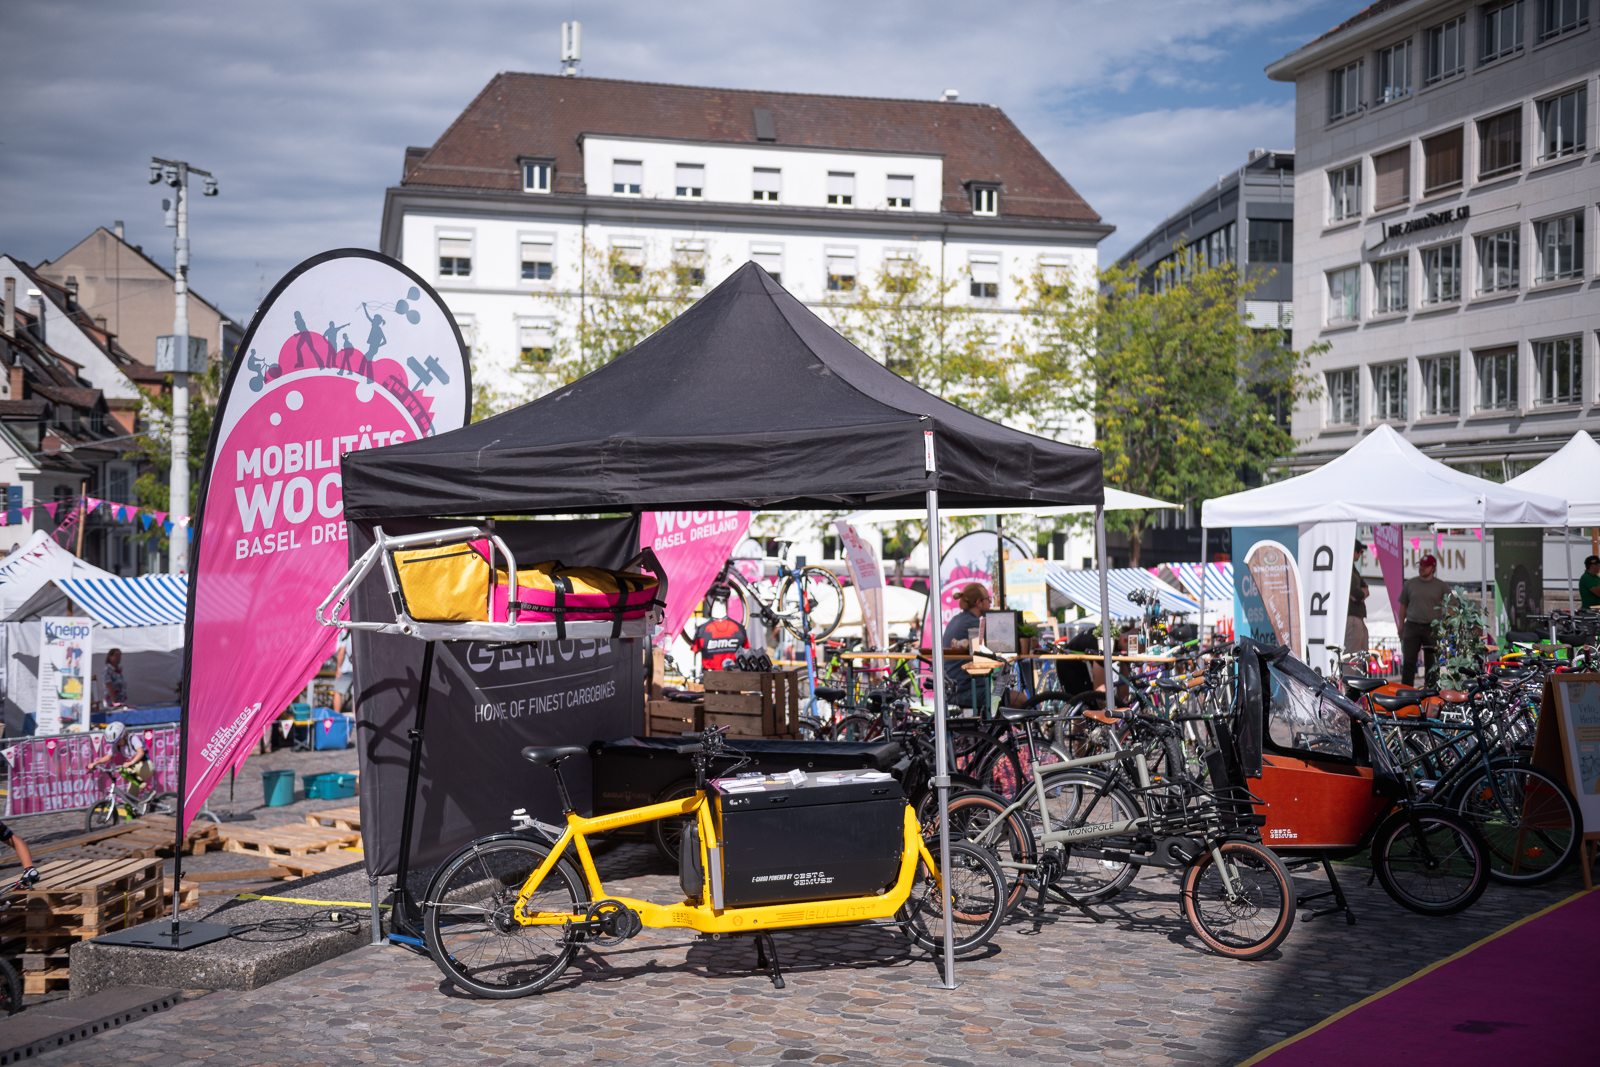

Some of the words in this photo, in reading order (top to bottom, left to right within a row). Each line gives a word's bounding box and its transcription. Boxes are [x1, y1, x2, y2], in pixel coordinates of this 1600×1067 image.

[236, 424, 406, 481] MOBILITÄTS
[234, 472, 344, 533] WOC
[236, 530, 301, 560] BASEL
[655, 532, 686, 551] BASEL
[690, 517, 738, 542] DREILAND
[1242, 602, 1264, 623] Less
[1306, 545, 1334, 676] IRD
[44, 622, 90, 639] Kneipp
[1251, 627, 1277, 645] More
[475, 702, 508, 722] HOME
[510, 700, 525, 718] OF
[528, 692, 565, 715] FINEST
[566, 680, 616, 708] CARGOBIKES
[200, 726, 229, 758] BASEL
[206, 706, 252, 763] UNTERWEGS
[215, 748, 232, 767] schlau
[230, 736, 241, 749] ans
[238, 725, 249, 738] Ziel
[595, 812, 642, 827] SUBMARINE
[1068, 822, 1114, 837] MONOPOLE
[751, 875, 769, 883] E-CARGO
[768, 873, 787, 881] POWERED
[805, 906, 870, 920] BULLITT
